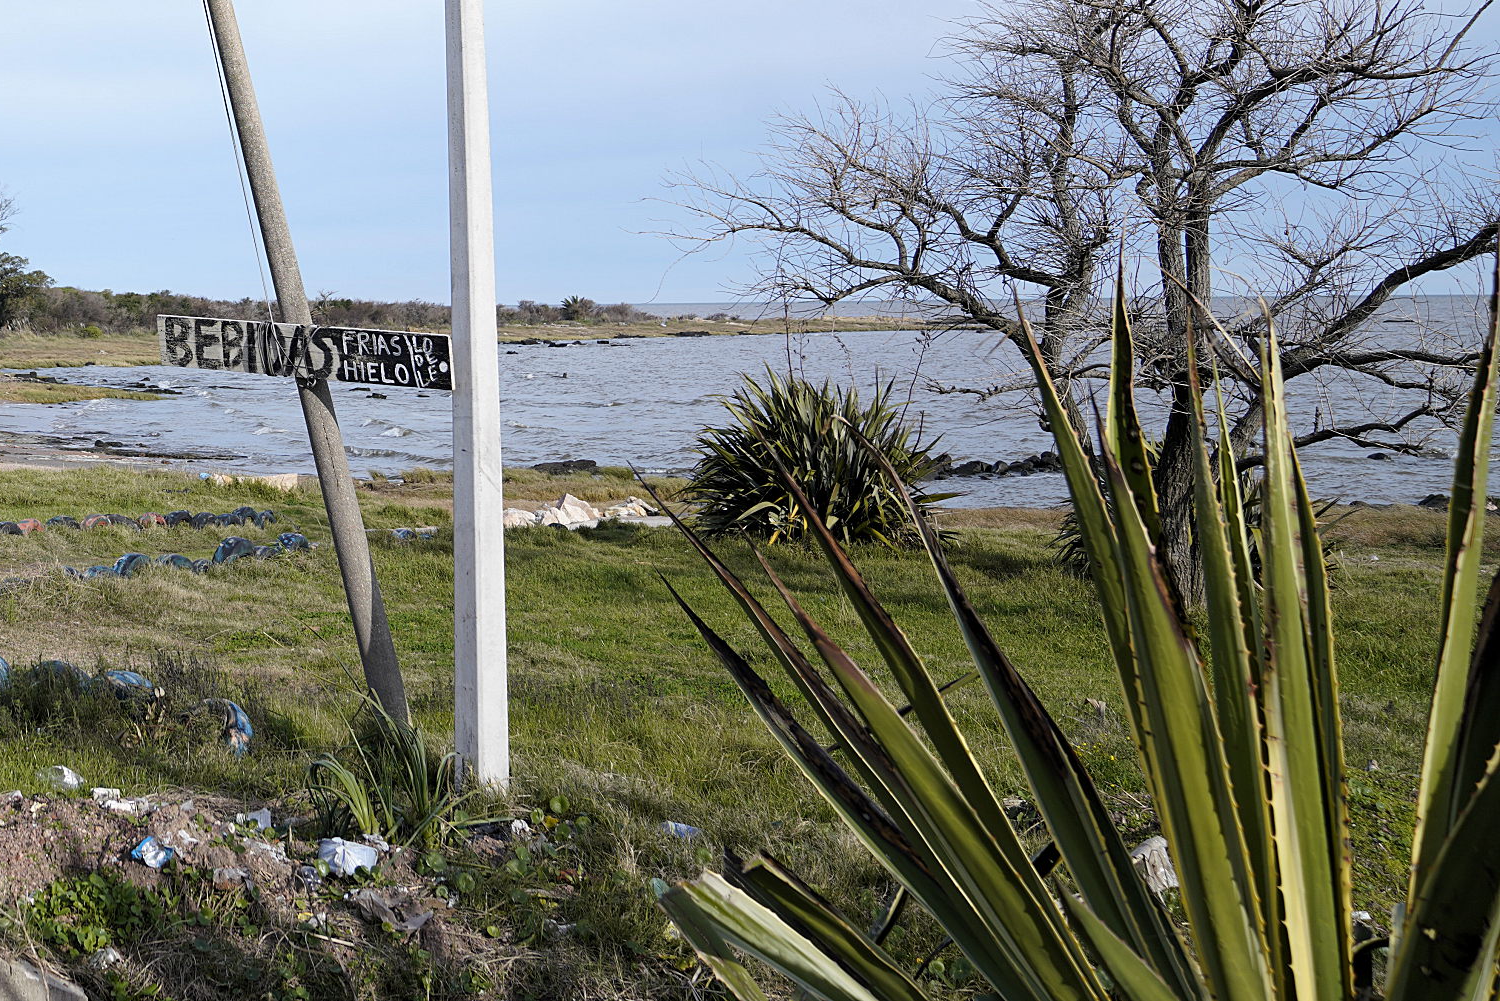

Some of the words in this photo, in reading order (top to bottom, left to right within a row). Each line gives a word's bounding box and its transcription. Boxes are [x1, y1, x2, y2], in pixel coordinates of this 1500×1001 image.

[165, 317, 336, 379] BEBIDAS
[342, 331, 402, 356] FRIAS
[412, 336, 433, 354] LO
[343, 360, 409, 384] HIELO
